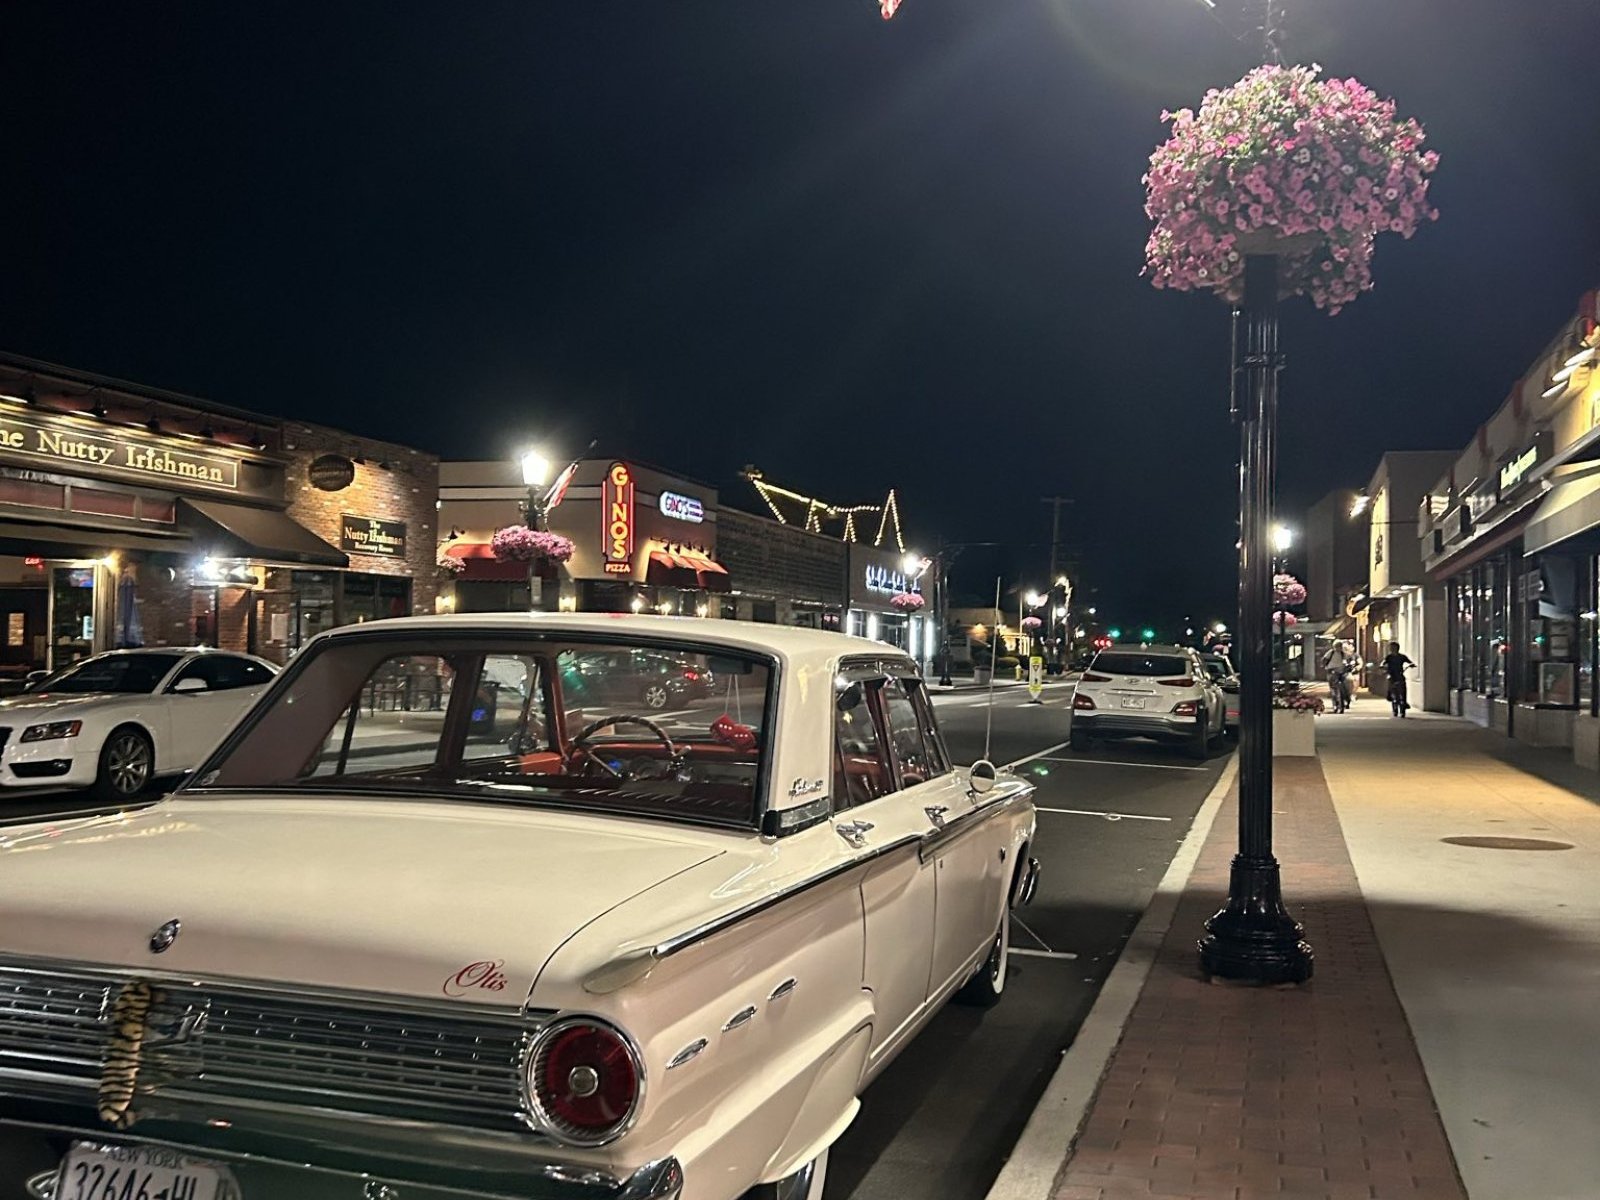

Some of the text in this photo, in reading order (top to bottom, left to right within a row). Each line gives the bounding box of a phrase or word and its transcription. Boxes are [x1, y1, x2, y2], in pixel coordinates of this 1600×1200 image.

[37, 430, 115, 464] Nutty
[125, 446, 223, 482] Irishman
[610, 466, 628, 559] GINOS
[344, 526, 368, 544] Nutty
[605, 563, 631, 573] PIZZA
[442, 958, 508, 998] Otis
[143, 1150, 184, 1170] YORK
